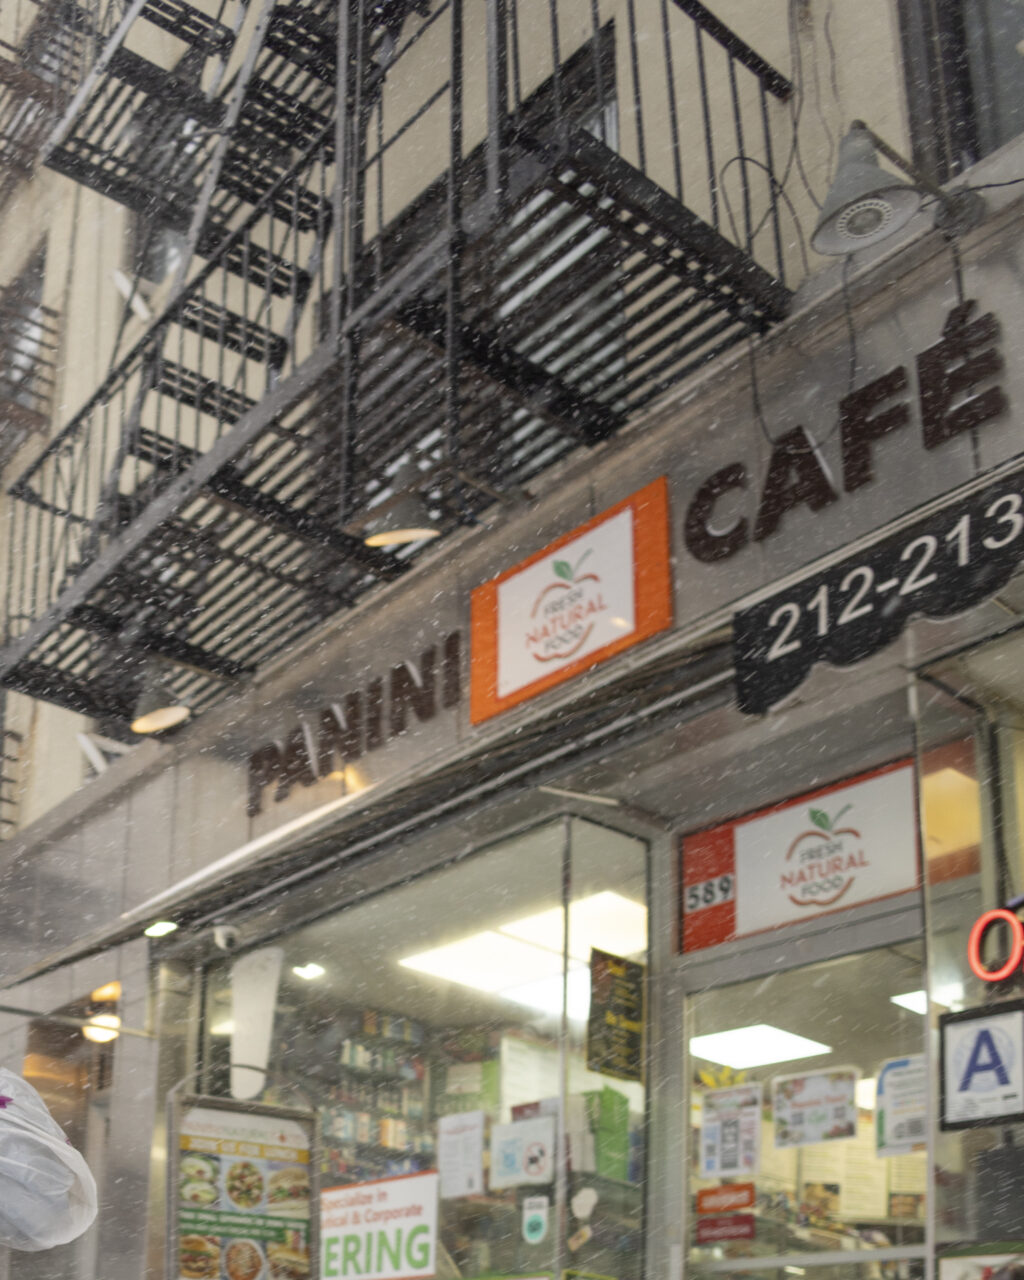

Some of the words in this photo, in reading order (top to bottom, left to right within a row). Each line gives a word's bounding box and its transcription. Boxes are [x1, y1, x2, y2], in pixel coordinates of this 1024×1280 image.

[683, 299, 1007, 564] CAFÉ
[544, 587, 583, 617] FRESH
[525, 594, 609, 649] NATURAL
[544, 624, 583, 652] FOOD
[247, 629, 462, 817] PANINI
[780, 850, 870, 890] NATURAL
[800, 841, 843, 863] FRESH
[687, 875, 734, 910] 589
[801, 874, 844, 899] FOOD
[958, 1029, 1010, 1092] A
[364, 1204, 423, 1225] Corporate
[324, 1223, 430, 1278] ERING
